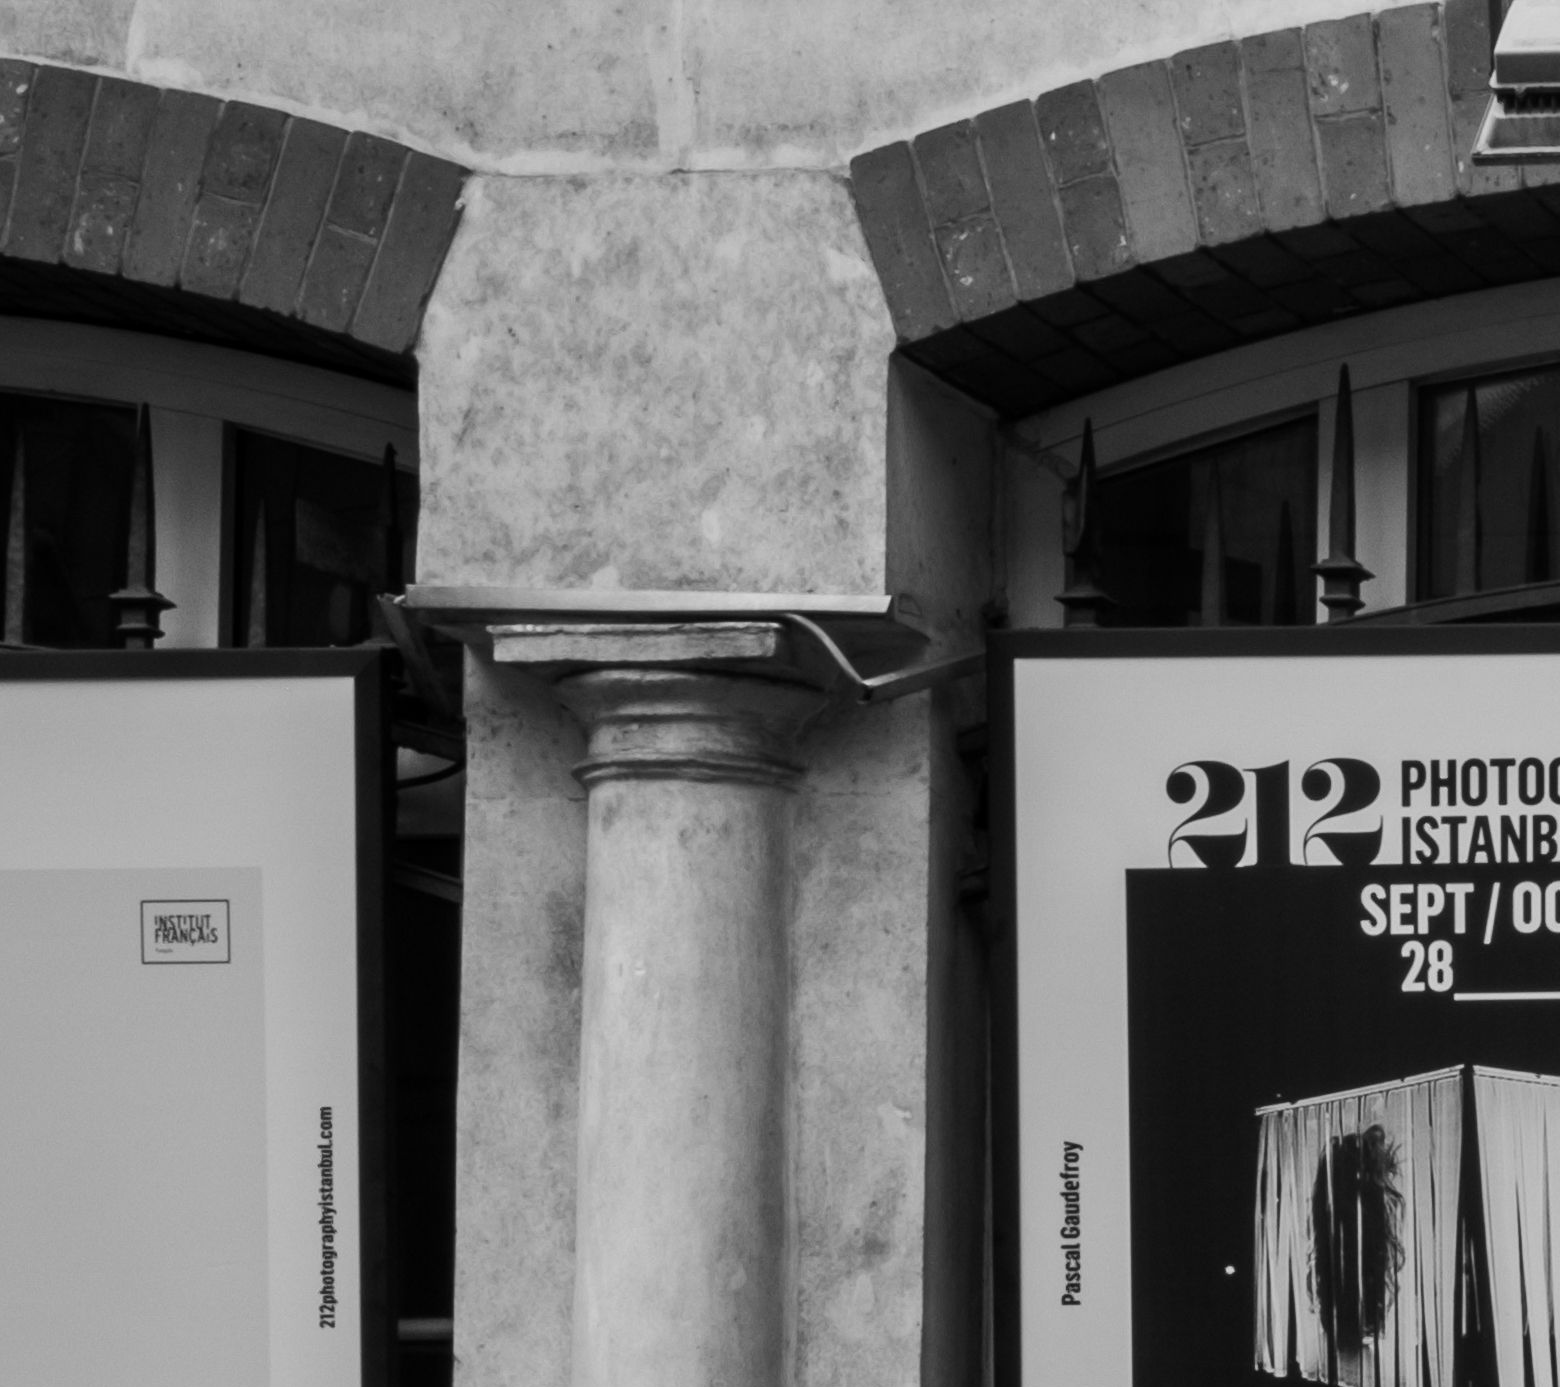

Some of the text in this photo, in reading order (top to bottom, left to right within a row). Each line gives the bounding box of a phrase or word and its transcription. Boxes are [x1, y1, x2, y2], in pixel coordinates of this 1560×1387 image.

[1166, 757, 1383, 867] 212
[1360, 882, 1474, 936] SEPT
[317, 1107, 337, 1328] 212photographyistanbul.com
[1059, 1141, 1083, 1305] Pascal Gaudefroy
